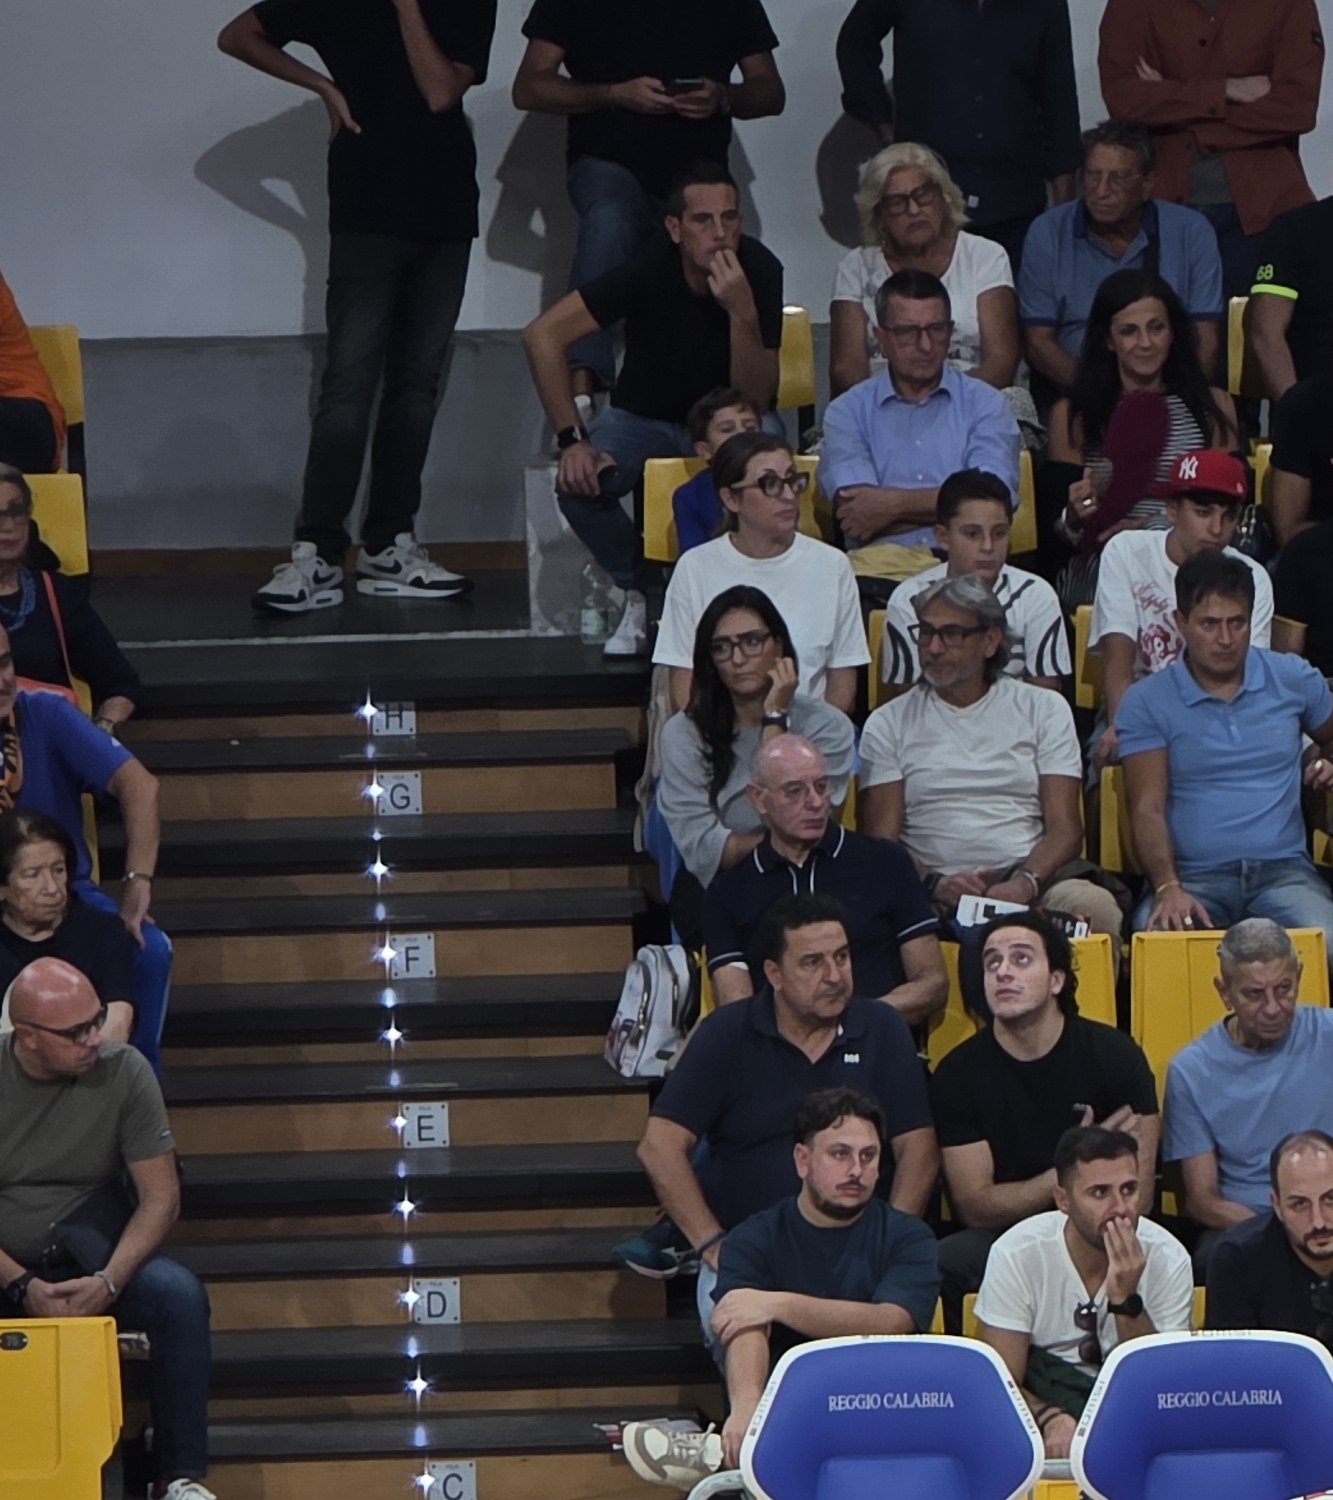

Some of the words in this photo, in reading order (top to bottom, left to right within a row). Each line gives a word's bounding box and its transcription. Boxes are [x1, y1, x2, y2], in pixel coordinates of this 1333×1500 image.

[385, 703, 404, 730] H
[389, 783, 411, 810] G
[404, 946, 420, 973] F
[416, 1114, 436, 1142] E
[426, 1291, 447, 1318] D
[828, 1393, 881, 1412] REGGIO
[883, 1391, 955, 1409] CALABRIA
[1157, 1391, 1210, 1410] REGGIO
[1211, 1389, 1283, 1407] CALABRIA
